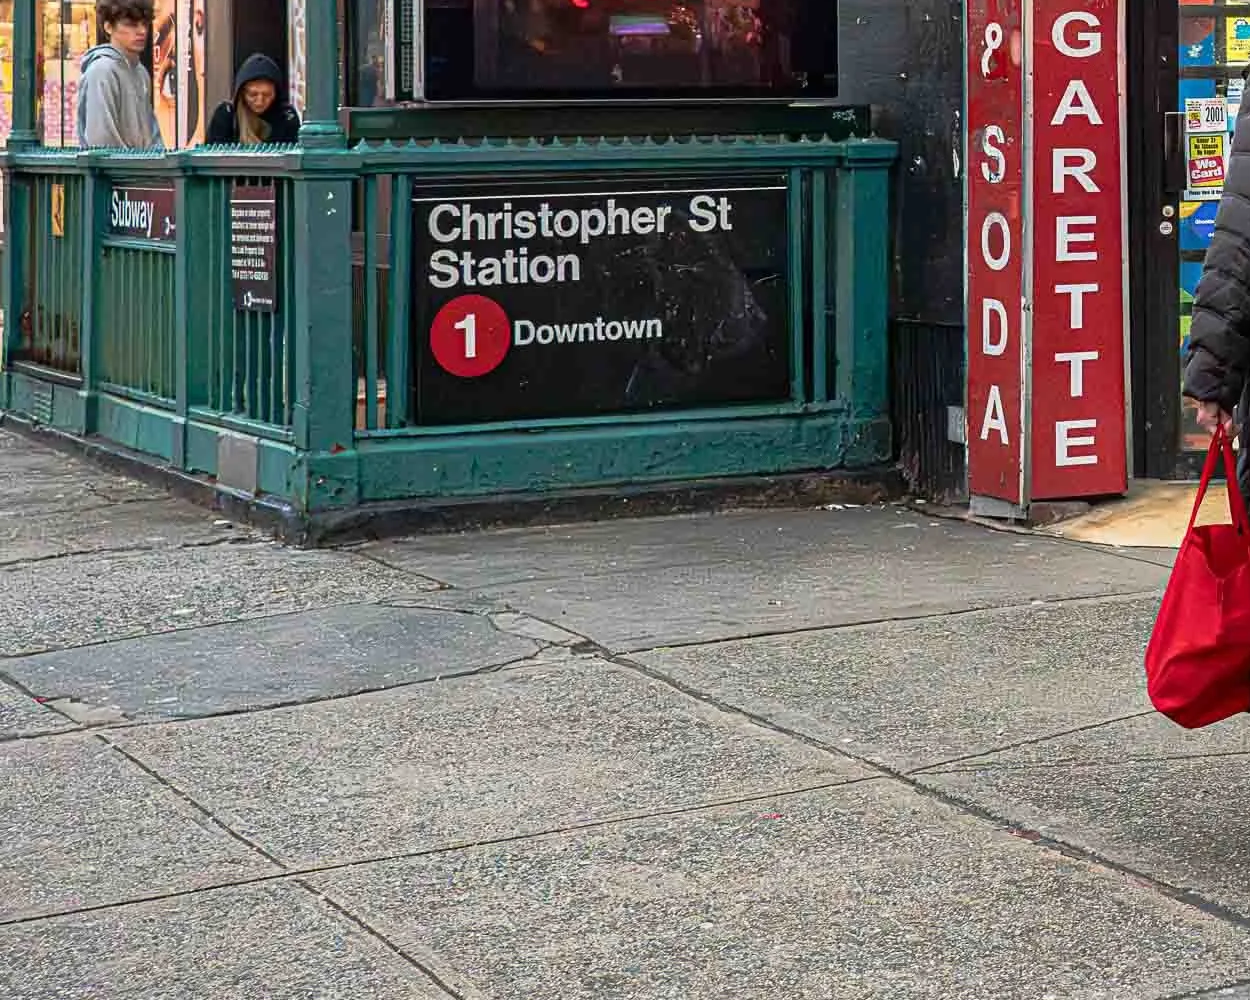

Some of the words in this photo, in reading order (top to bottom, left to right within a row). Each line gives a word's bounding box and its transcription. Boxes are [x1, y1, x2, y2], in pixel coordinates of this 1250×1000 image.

[1205, 106, 1225, 123] 2001
[1191, 166, 1223, 179] Card
[1196, 159, 1217, 168] We
[112, 190, 154, 238] Subway
[428, 199, 672, 243] Christopher
[688, 195, 733, 233] St
[428, 248, 581, 289] Station
[980, 125, 1011, 446] SODA
[454, 314, 477, 359] 1
[514, 315, 663, 347] Downtown
